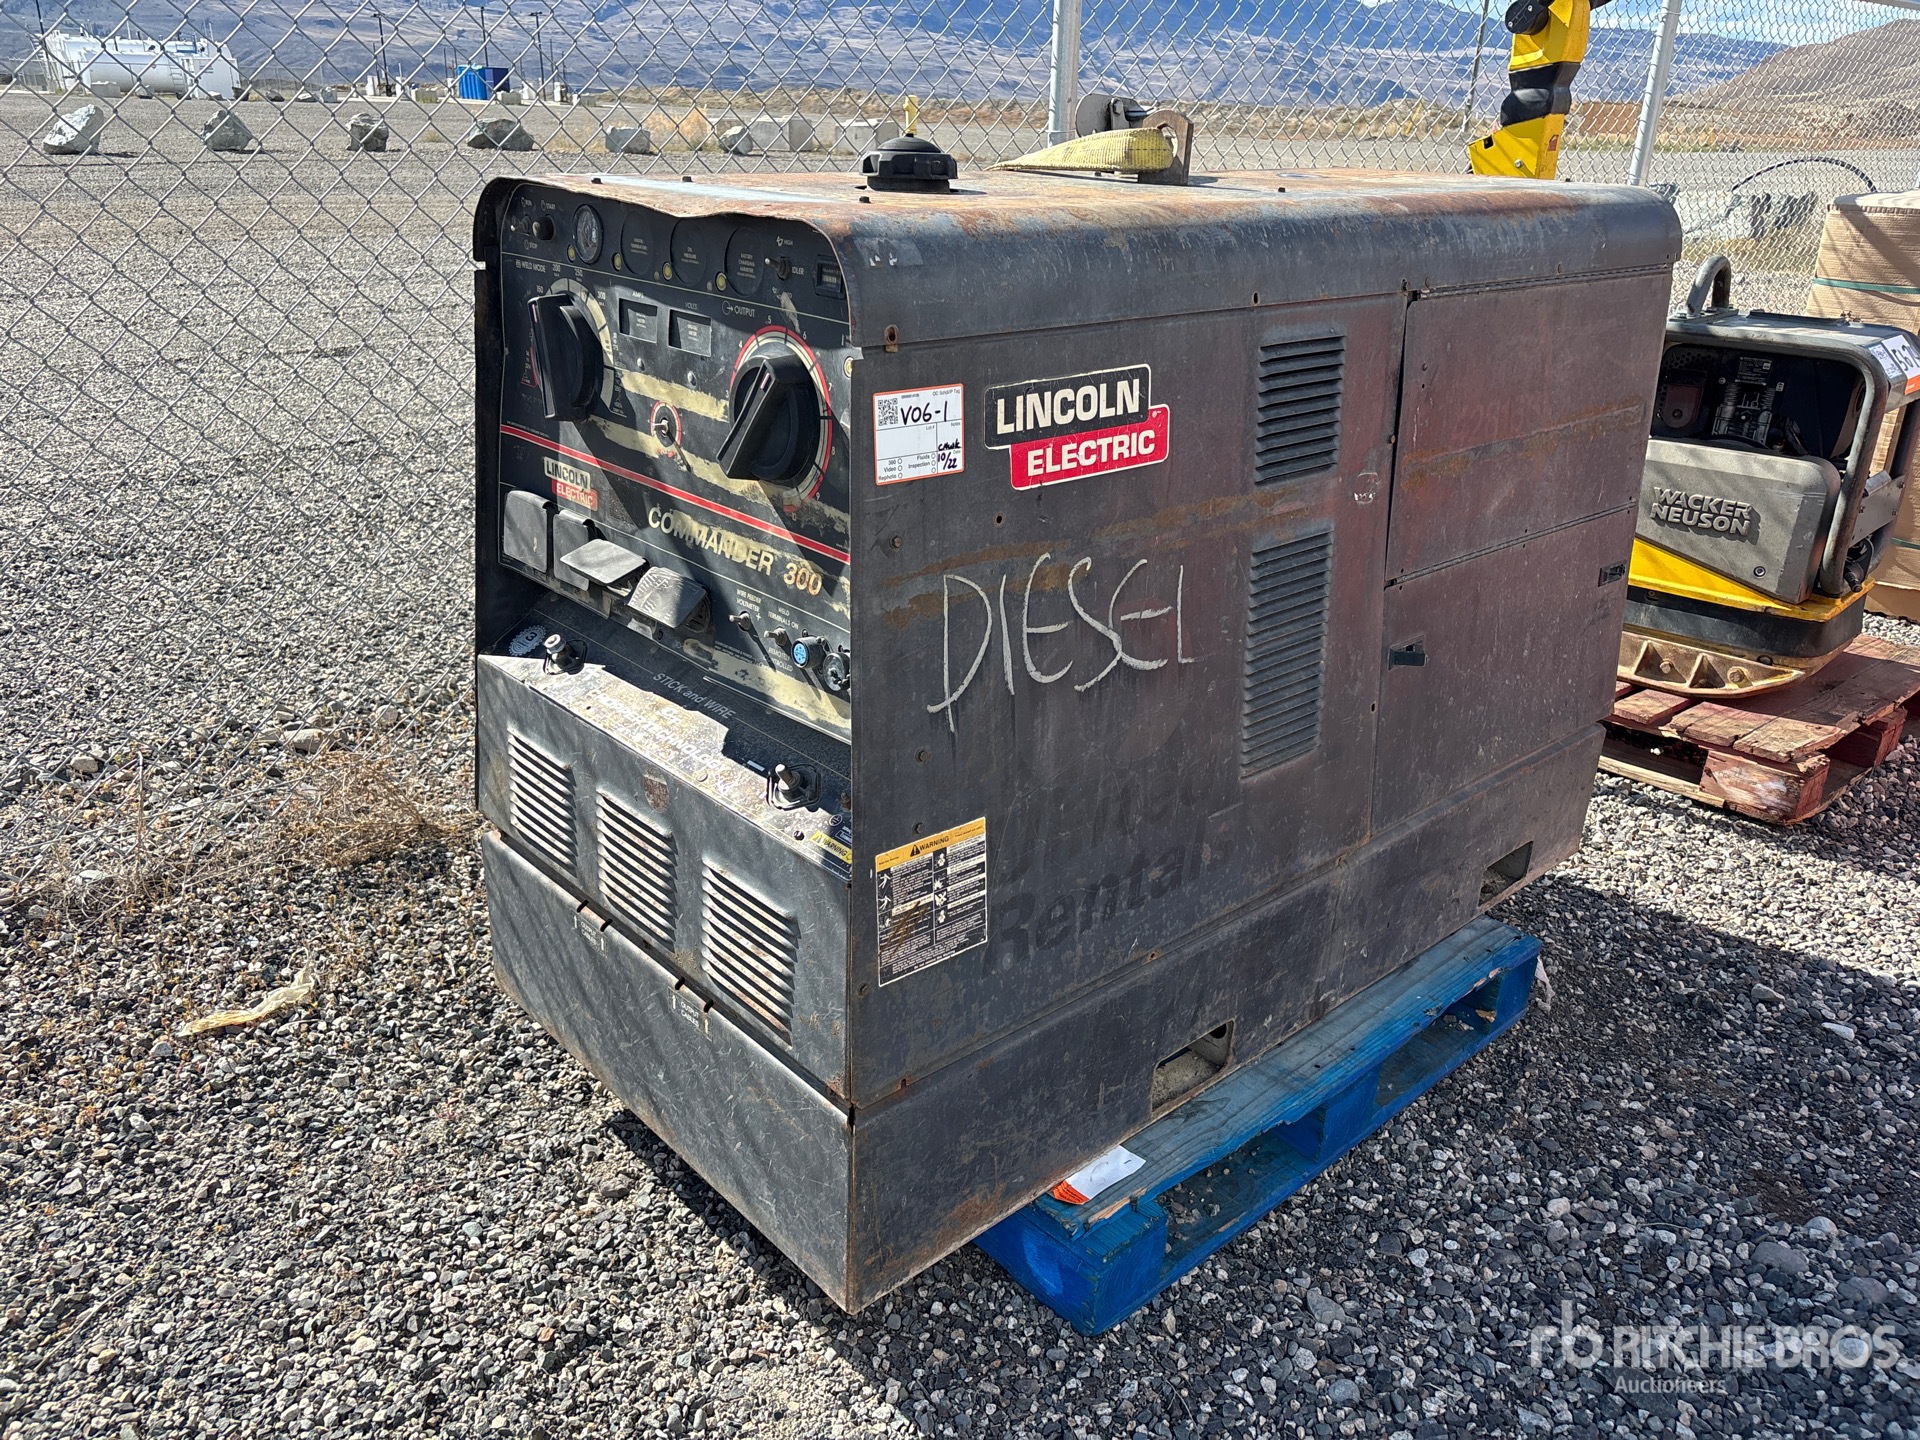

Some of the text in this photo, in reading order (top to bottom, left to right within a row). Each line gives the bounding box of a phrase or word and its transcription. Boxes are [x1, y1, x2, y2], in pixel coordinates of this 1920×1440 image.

[521, 260, 546, 274] WELD MODE
[552, 263, 561, 273] 200
[791, 266, 805, 276] IDLER
[597, 291, 606, 300] 300
[685, 301, 698, 310] VOLTS
[733, 307, 756, 318] OUTPUT
[767, 315, 772, 324] 5
[802, 331, 807, 340] 6
[725, 389, 730, 398] 3
[900, 400, 948, 426] V06-1
[996, 378, 1140, 435] LINCOLN
[937, 451, 958, 470] 10/22
[1027, 429, 1156, 477] ELECTRIC
[908, 461, 931, 469] Inspection
[546, 460, 588, 489] LINCOLN
[556, 483, 594, 506] ELECTRIC
[1653, 486, 1753, 519] WACKER
[1650, 502, 1751, 536] NEUSON
[648, 506, 823, 596] COMMANDER 300
[736, 598, 760, 613] VOLTMETER
[777, 606, 790, 617] WELD
[767, 611, 799, 630] TERMINALS ON
[926, 552, 1198, 733] DIESEL
[653, 673, 687, 693] STICK
[682, 689, 708, 704] and
[703, 698, 737, 720] WIRE
[919, 835, 950, 851] WARNING
[580, 921, 597, 936] OUTPUT
[580, 928, 597, 946] CABLES
[680, 1001, 700, 1019] OUTPUT
[680, 1010, 700, 1028] CABLES
